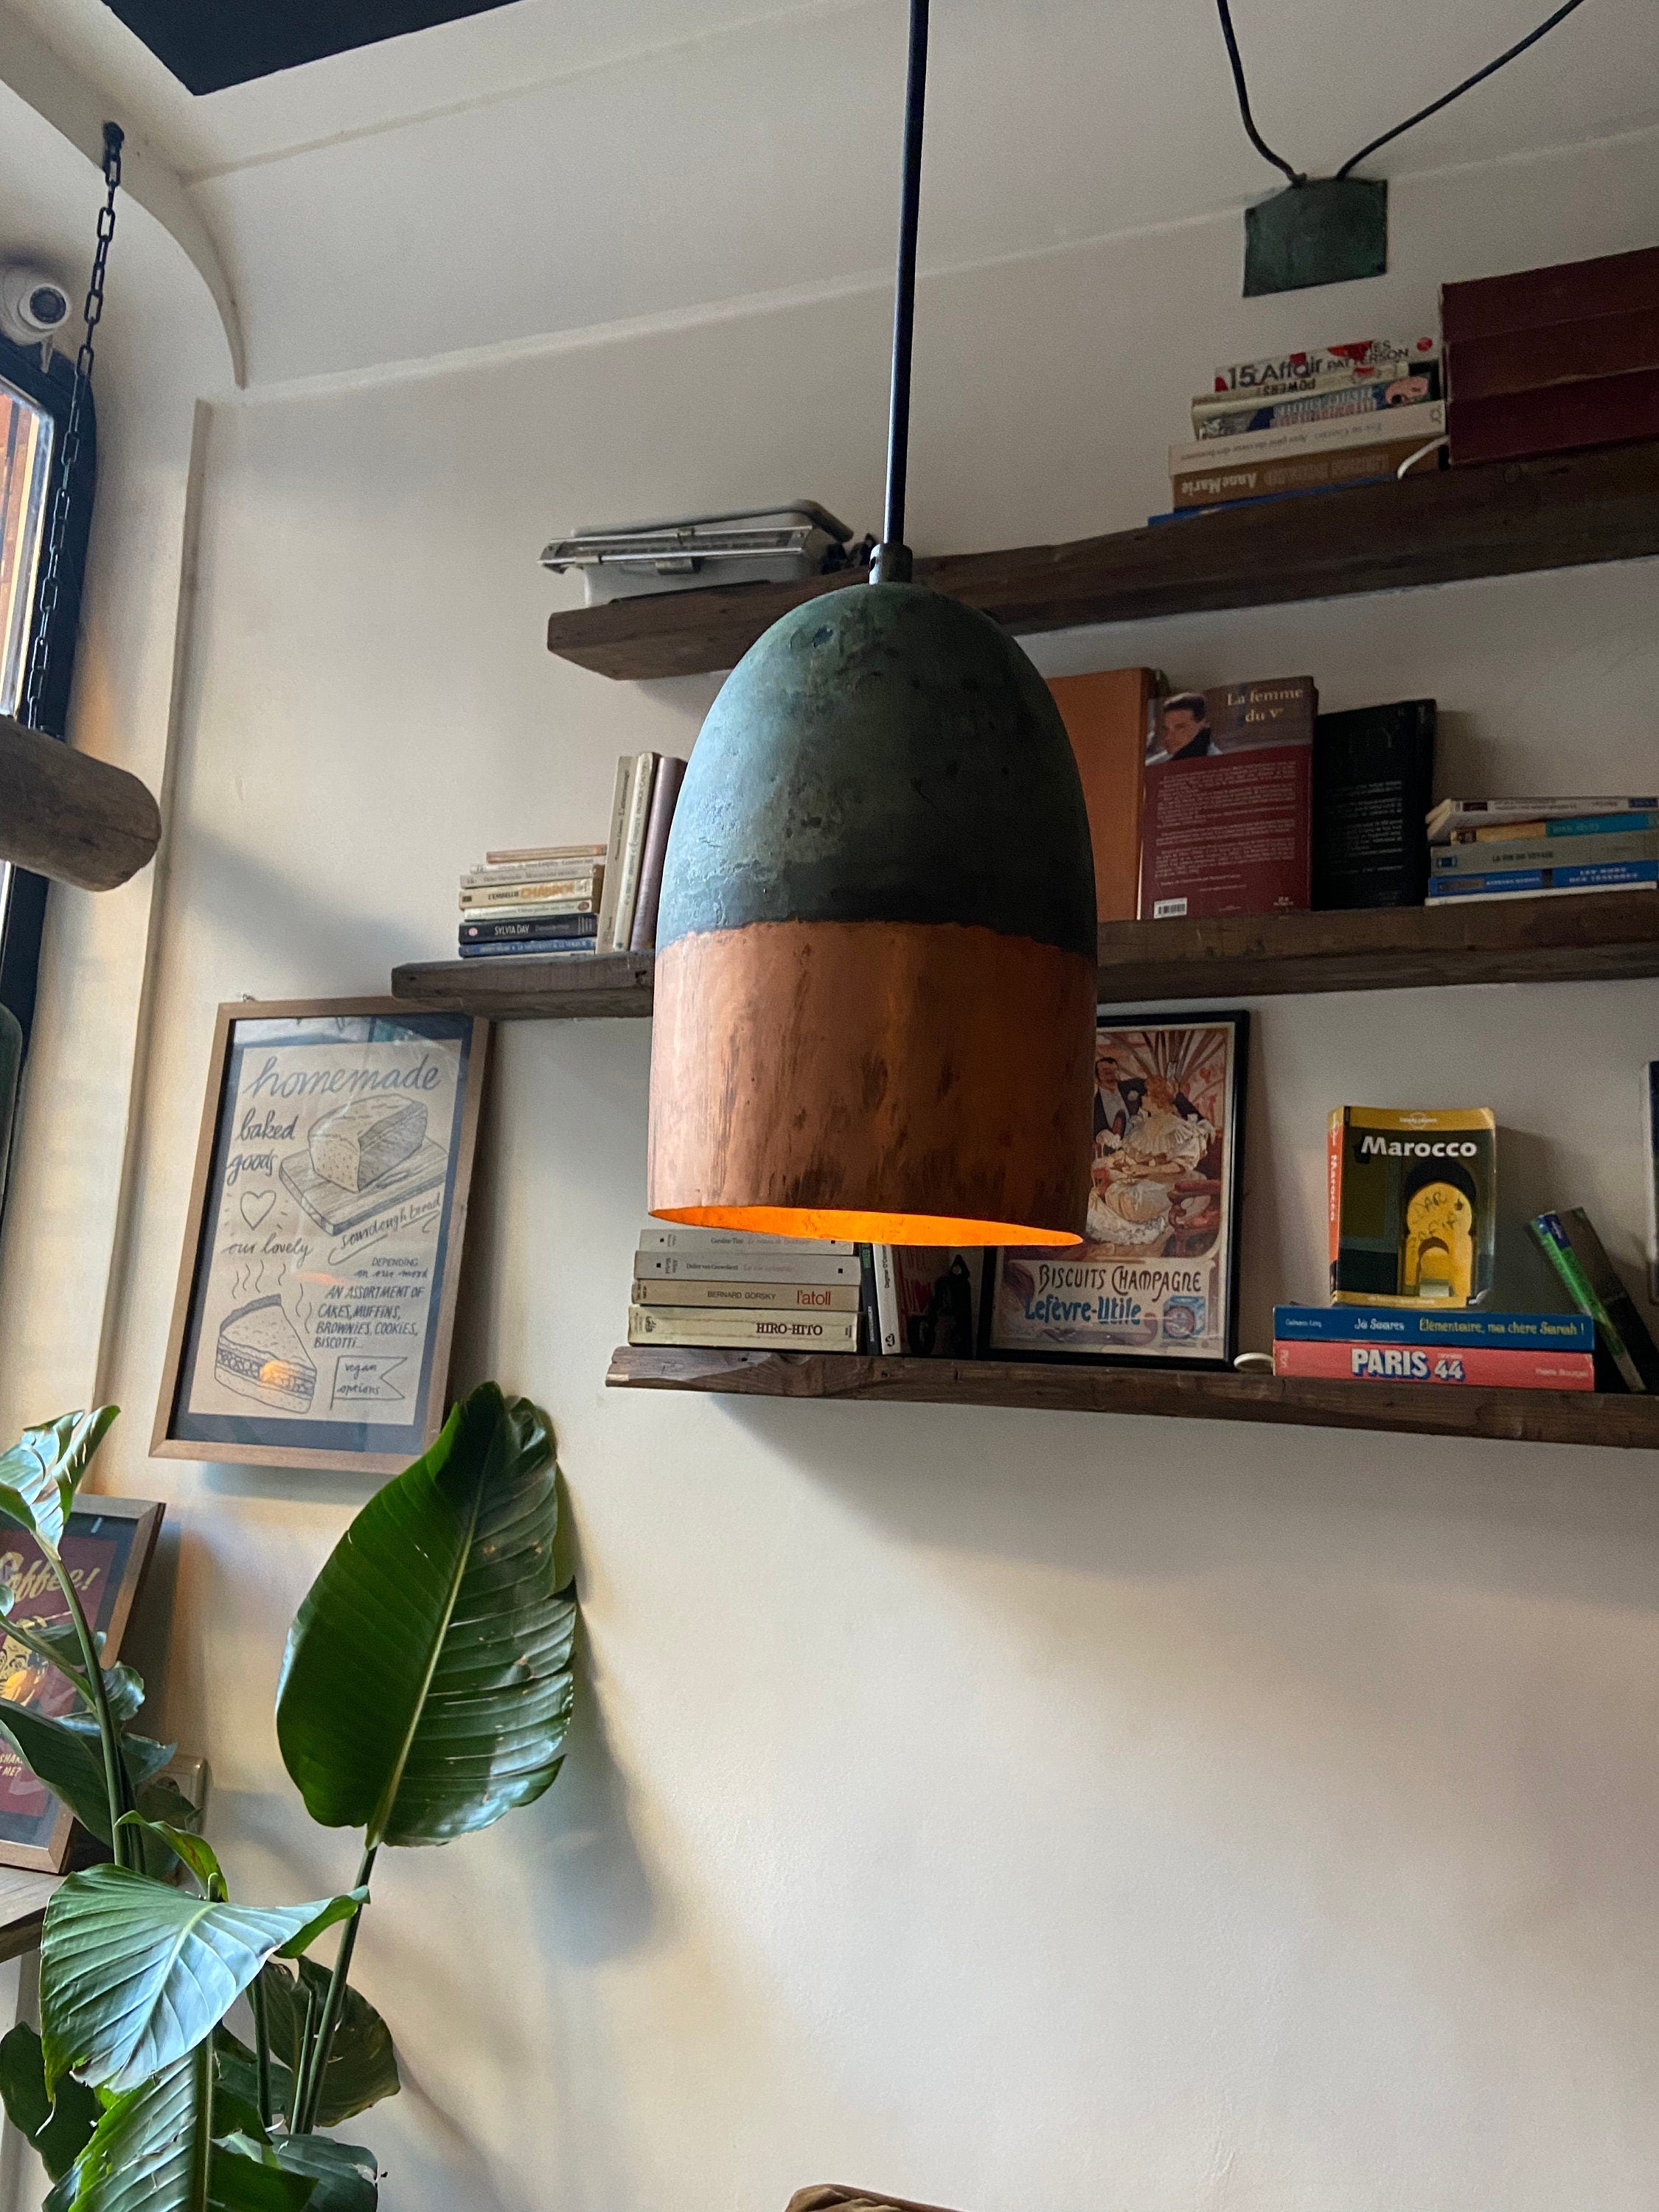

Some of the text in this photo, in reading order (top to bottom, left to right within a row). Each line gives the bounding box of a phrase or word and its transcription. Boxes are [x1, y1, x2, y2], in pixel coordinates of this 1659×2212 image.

[1227, 688, 1304, 706] La femme
[1245, 709, 1265, 723] du
[494, 923, 516, 936] SYLVIA
[517, 923, 529, 935] DAY
[243, 1054, 442, 1098] homemade
[237, 1107, 299, 1141] baked
[1361, 1135, 1478, 1158] Marocco
[226, 1148, 277, 1186] goods
[341, 1192, 441, 1250] sourdough bread
[222, 1232, 314, 1269] our lovely
[372, 1256, 419, 1267] DEPENDING
[354, 1267, 428, 1278] on our mood
[1038, 1264, 1201, 1302] BISCUITS CHAMPAGNE
[324, 1285, 425, 1299] AN ASSORTMENT OF
[708, 1290, 832, 1306] BERNARD GORSKY l'atoll
[1025, 1294, 1142, 1325] Lefèvre-Utile
[375, 1321, 418, 1336] COOKIES,
[756, 1322, 823, 1336] HIRO-HITO
[1369, 1318, 1405, 1331] Soares
[1488, 1323, 1505, 1333] ma
[1540, 1321, 1577, 1335] Sarah
[345, 1364, 377, 1380] vegan
[1351, 1348, 1430, 1380] PARIS
[1433, 1359, 1465, 1381] 44
[336, 1383, 380, 1396] options
